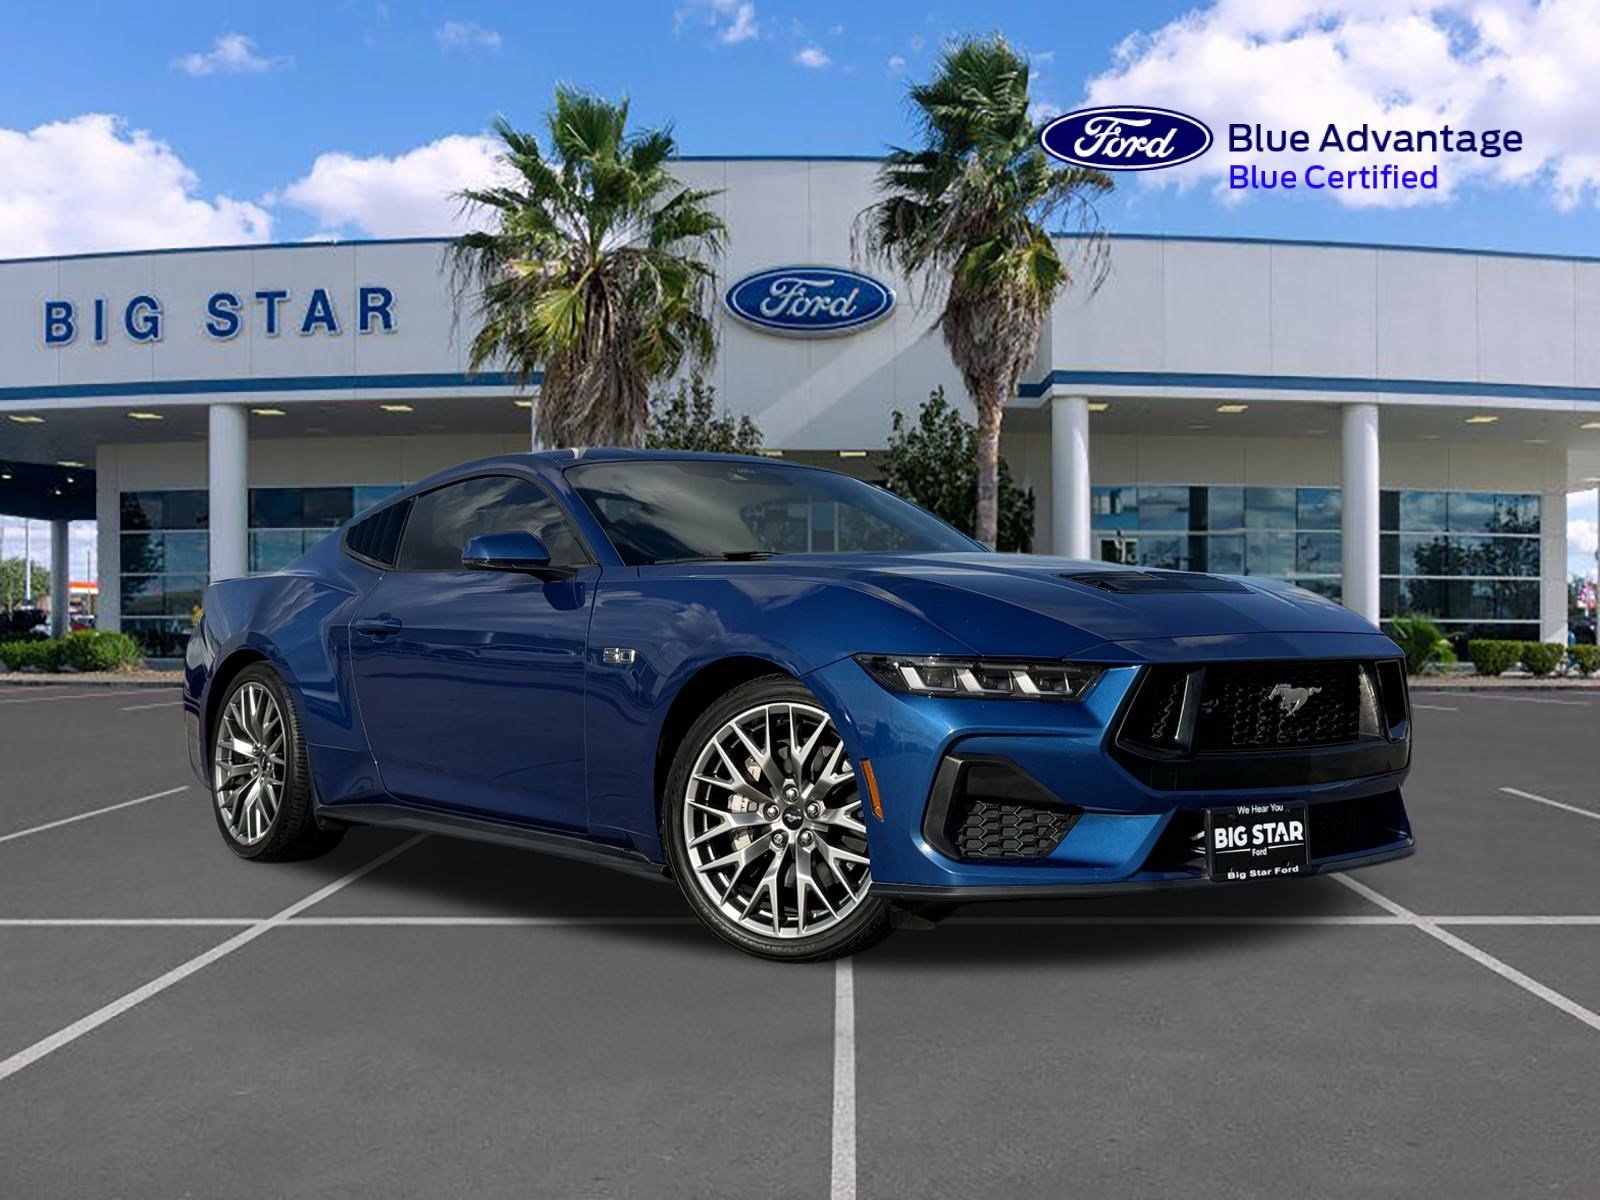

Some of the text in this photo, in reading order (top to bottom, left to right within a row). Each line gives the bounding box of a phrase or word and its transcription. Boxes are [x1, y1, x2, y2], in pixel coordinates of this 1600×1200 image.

[760, 277, 859, 317] Ford
[44, 286, 397, 345] BIG STAR
[1237, 803, 1284, 815] We Hear You
[1214, 821, 1304, 849] BIG STAR
[1252, 847, 1267, 856] Ford
[1227, 865, 1299, 879] Big Star Ford
